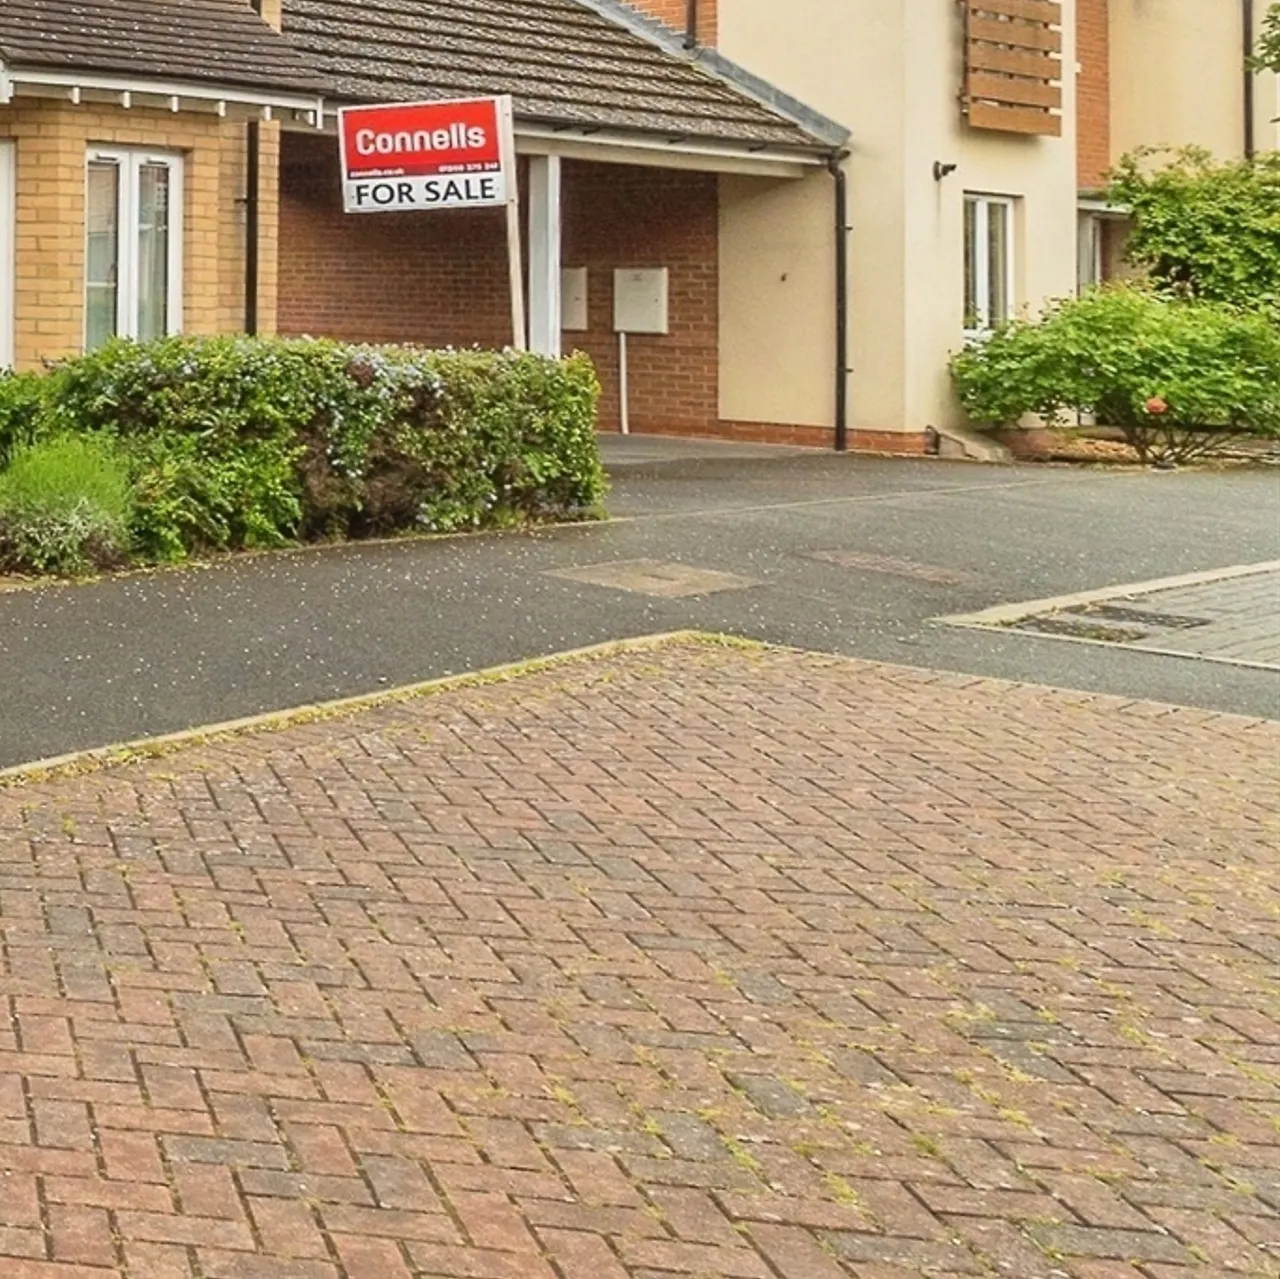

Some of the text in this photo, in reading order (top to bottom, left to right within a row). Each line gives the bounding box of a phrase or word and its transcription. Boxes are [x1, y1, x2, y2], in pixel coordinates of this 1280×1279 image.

[355, 123, 487, 155] Connells
[355, 177, 496, 206] FOR SALE
